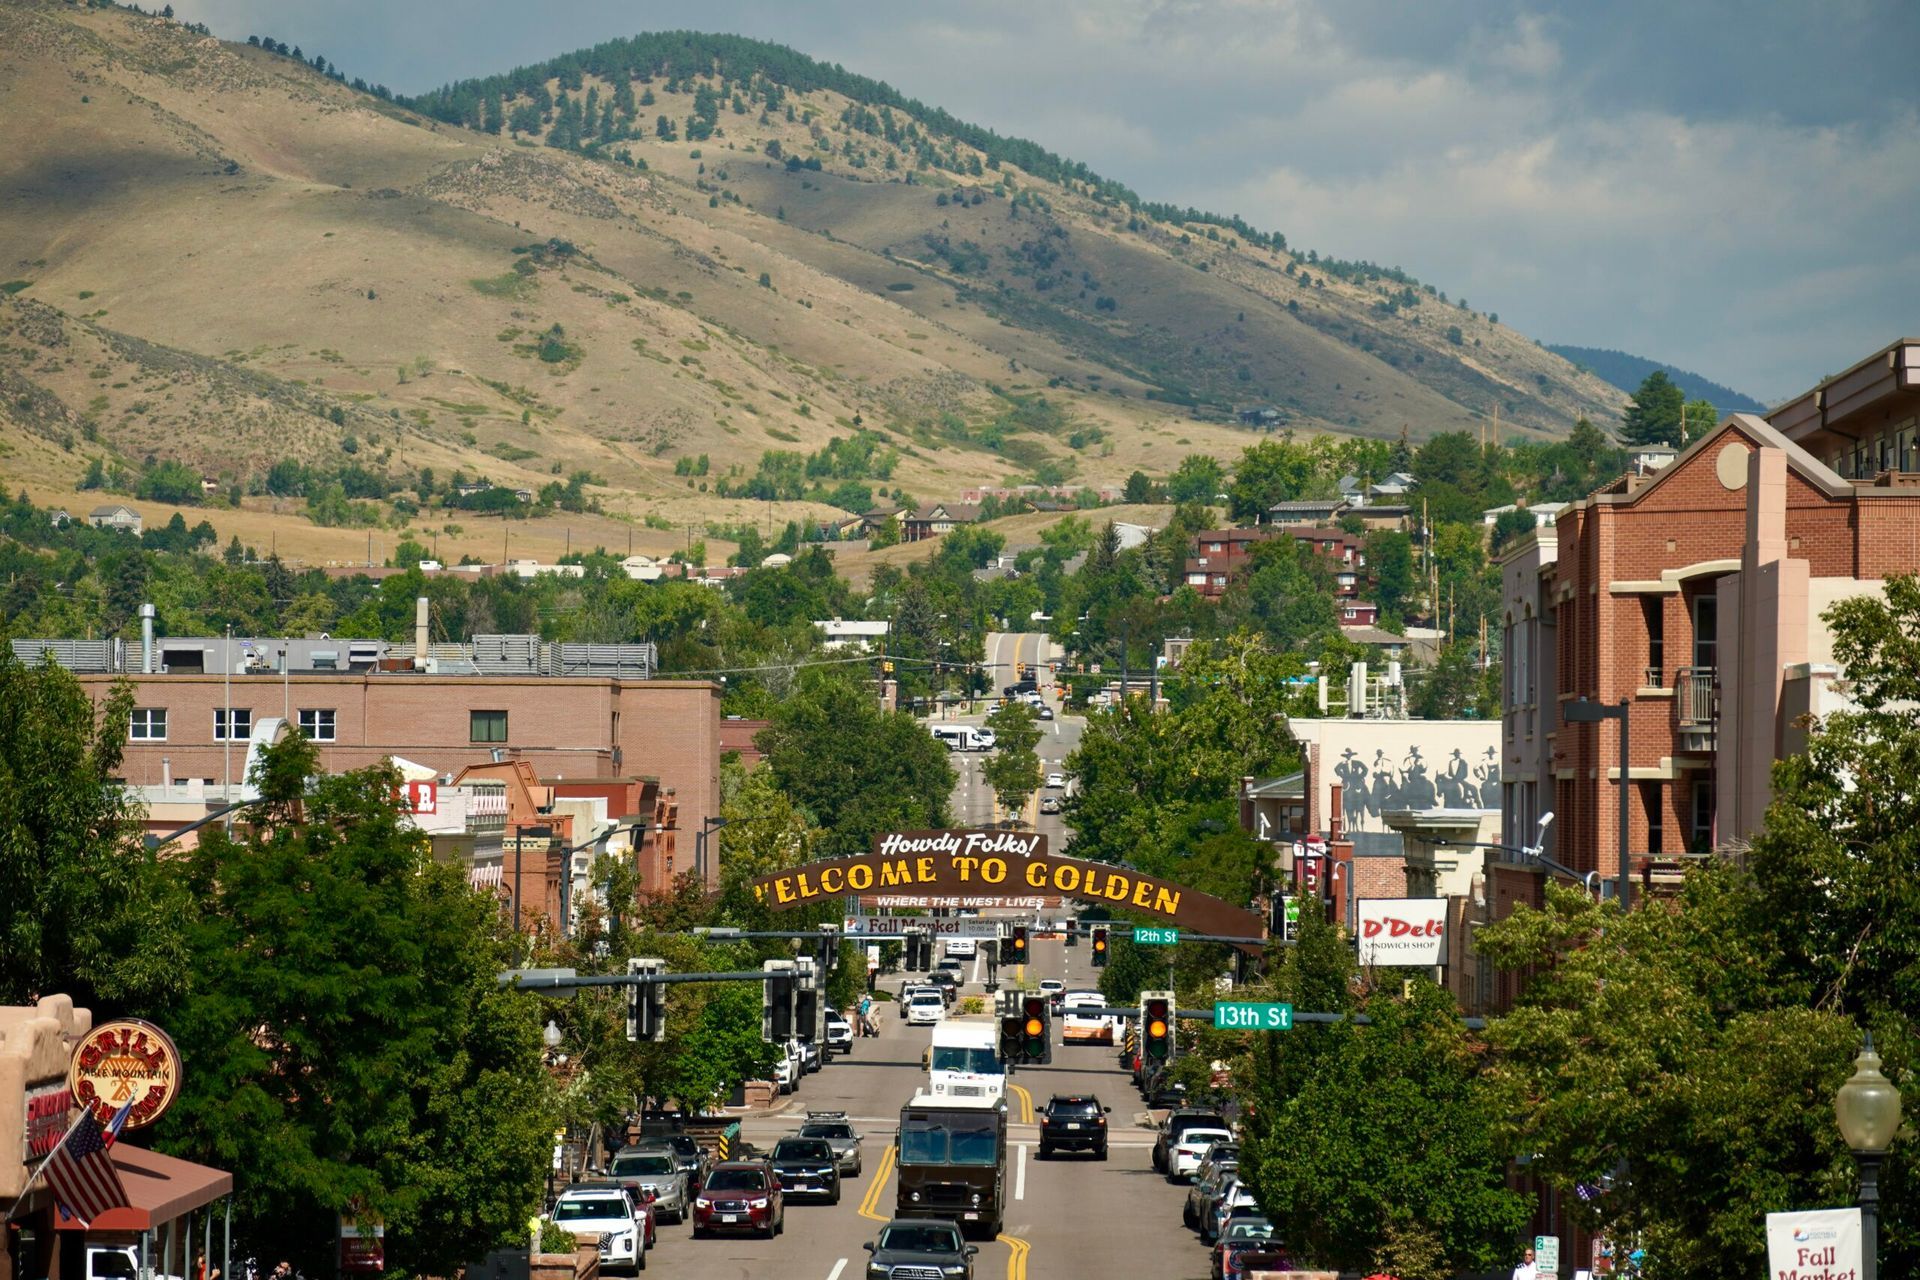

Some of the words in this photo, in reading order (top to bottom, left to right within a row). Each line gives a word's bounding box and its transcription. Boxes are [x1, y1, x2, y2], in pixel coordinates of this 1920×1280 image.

[880, 833, 961, 856] Howdy
[965, 833, 1040, 857] Folks!
[951, 857, 1007, 883] TO
[1025, 862, 1181, 915] GOLDEN
[877, 896, 927, 906] WHERE
[932, 896, 960, 906] THE
[963, 896, 1001, 907] WEST
[1006, 897, 1045, 908] LIVES
[869, 918, 898, 933] Fall
[1363, 917, 1444, 938] D'Deli
[1136, 930, 1160, 942] 12th
[1164, 931, 1177, 943] St
[1219, 1006, 1260, 1026] 13th
[1268, 1007, 1288, 1027] St
[81, 1029, 166, 1069] GRILL
[79, 1067, 108, 1078] TABLE
[112, 1068, 170, 1079] MOUNTAIN
[79, 1080, 167, 1121] CANINA
[1797, 1246, 1836, 1267] Fall
